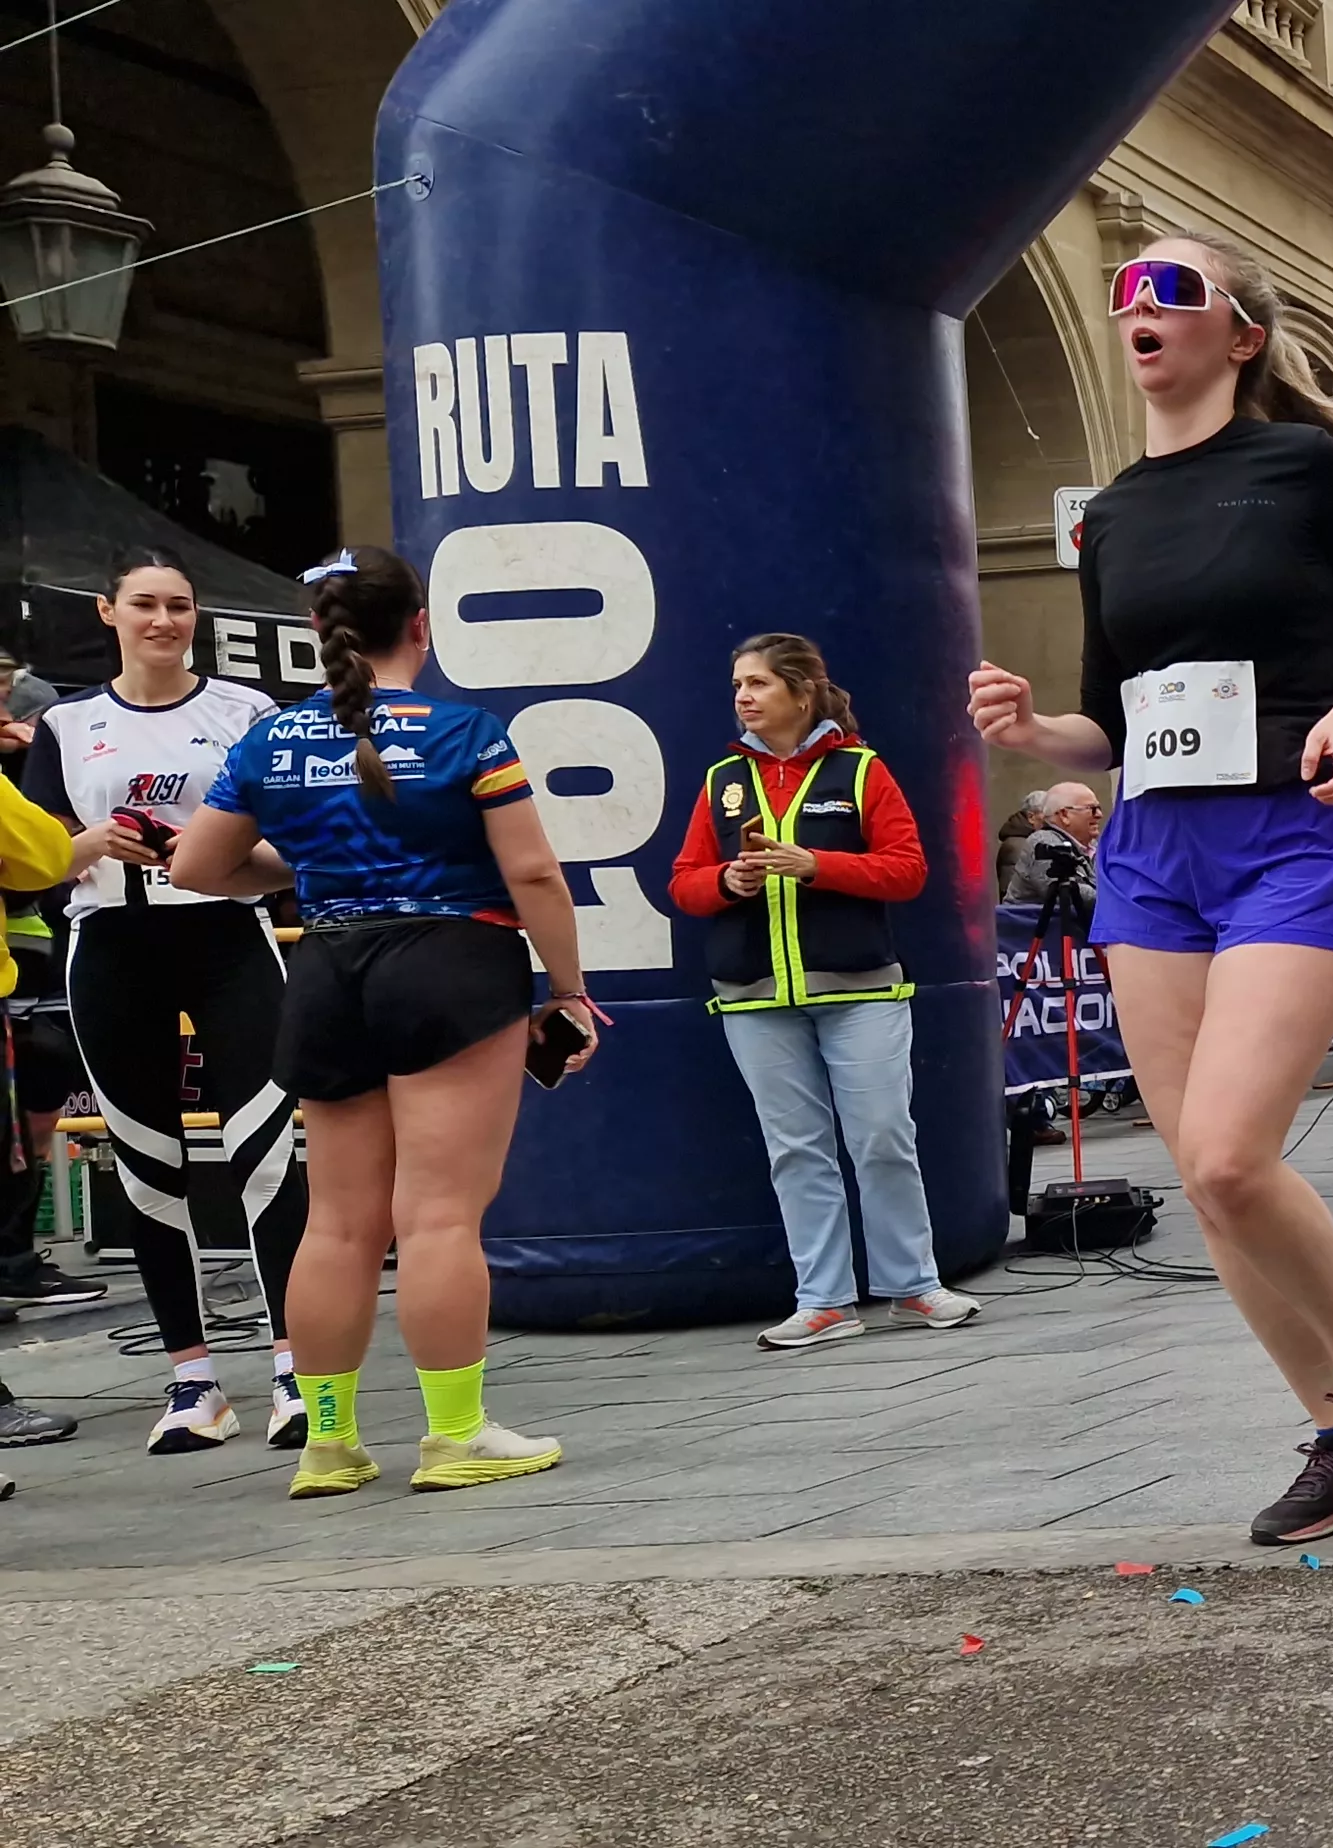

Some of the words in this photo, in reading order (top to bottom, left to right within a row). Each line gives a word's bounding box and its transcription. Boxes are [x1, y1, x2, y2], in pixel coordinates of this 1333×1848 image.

[413, 331, 650, 500] RUTA
[273, 703, 392, 726] POLA
[1145, 728, 1201, 760] 609
[996, 948, 1108, 990] POLIC
